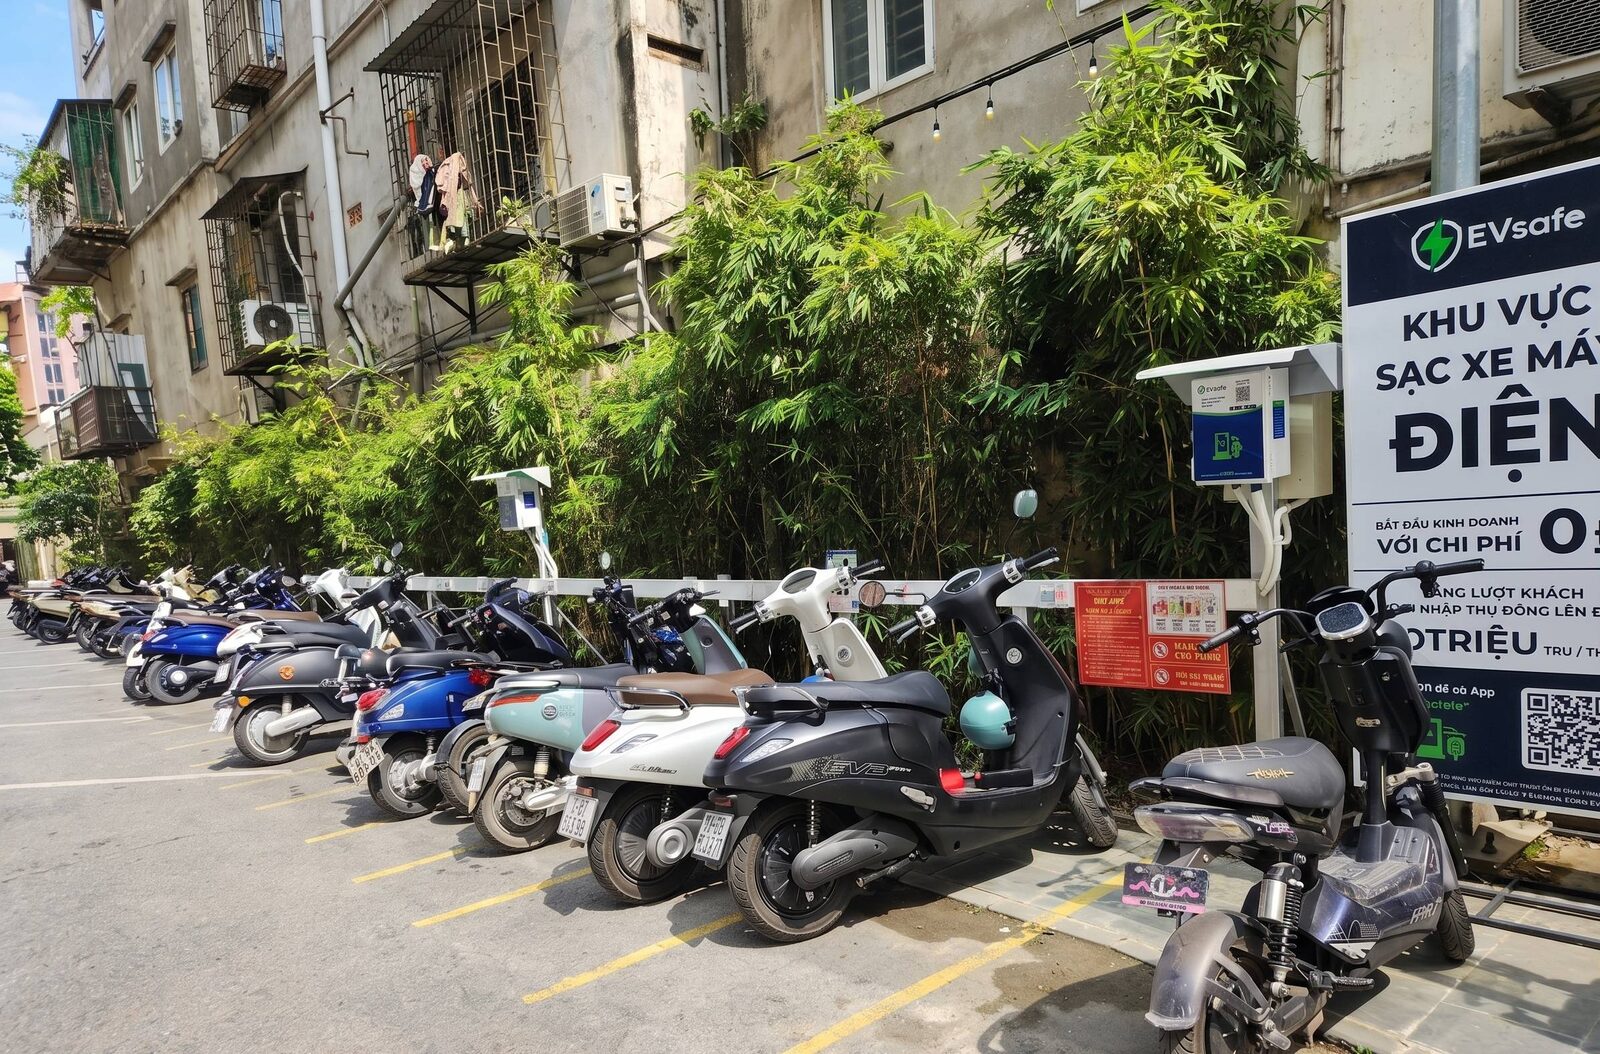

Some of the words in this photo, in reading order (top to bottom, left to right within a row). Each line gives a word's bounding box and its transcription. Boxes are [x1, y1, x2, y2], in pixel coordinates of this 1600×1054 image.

[1468, 207, 1586, 249] EVsafe
[1403, 301, 1485, 342] KHU
[1497, 283, 1592, 330] VỰC
[1376, 356, 1451, 396] SẠC
[1462, 347, 1514, 382] XE
[1389, 383, 1600, 483] ĐIỆN
[1433, 518, 1465, 529] KINH
[1469, 516, 1519, 527] DOANH
[1377, 534, 1418, 554] VỚI
[1426, 536, 1468, 553] CHI
[1477, 530, 1523, 552] PHÍ
[1471, 586, 1516, 602] LƯỢT
[1521, 585, 1584, 600] KHÁCH
[1420, 602, 1462, 617] NHẬP
[1466, 605, 1497, 618] THỤ
[1554, 603, 1587, 617] LÊN
[1470, 686, 1495, 698] App
